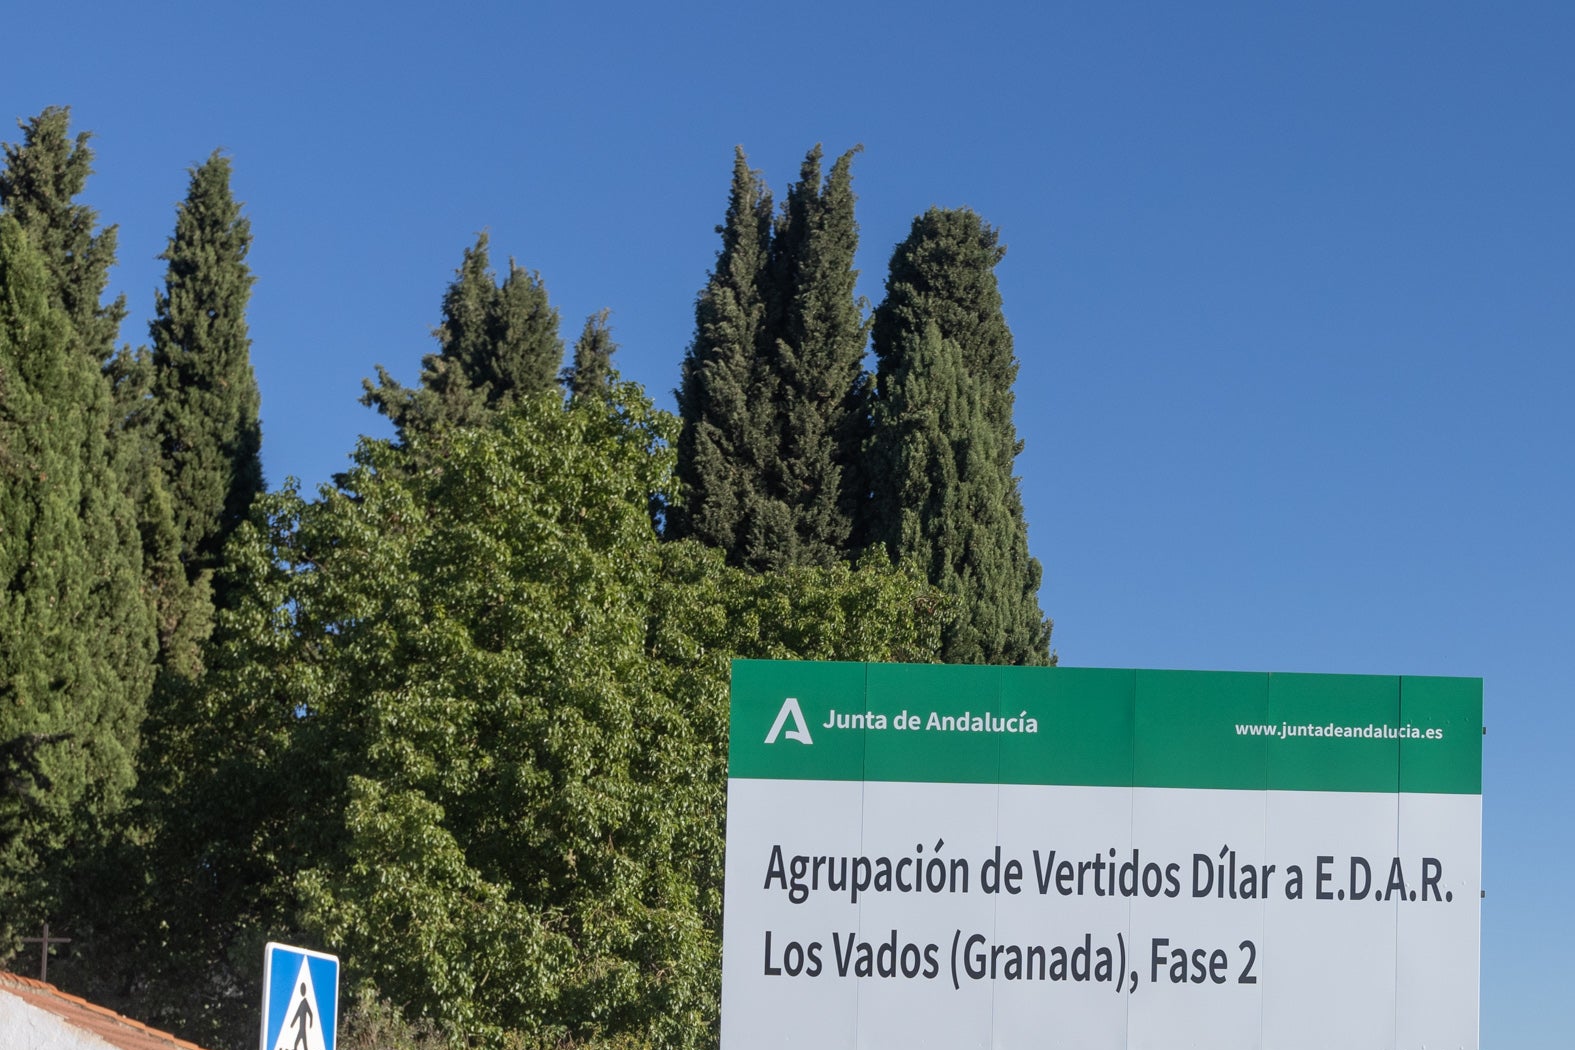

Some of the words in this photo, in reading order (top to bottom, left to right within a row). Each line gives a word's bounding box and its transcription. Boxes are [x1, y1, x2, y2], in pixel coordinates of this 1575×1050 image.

[822, 708, 887, 731] Junta
[893, 709, 921, 731] de
[925, 710, 1038, 734] Andalucía
[1235, 721, 1443, 741] www.juntadeandalucia.es
[763, 837, 969, 905] Agrupación
[980, 845, 1023, 895] de
[1032, 847, 1181, 898] Vertidos
[1192, 844, 1276, 900] Dílar
[1284, 864, 1303, 900] a
[1315, 855, 1453, 903] E.D.A.R.
[764, 930, 823, 978] Los
[832, 929, 939, 979] Vados
[950, 929, 1139, 994] (Granada),
[1151, 937, 1228, 985] Fase
[1237, 940, 1257, 984] 2
